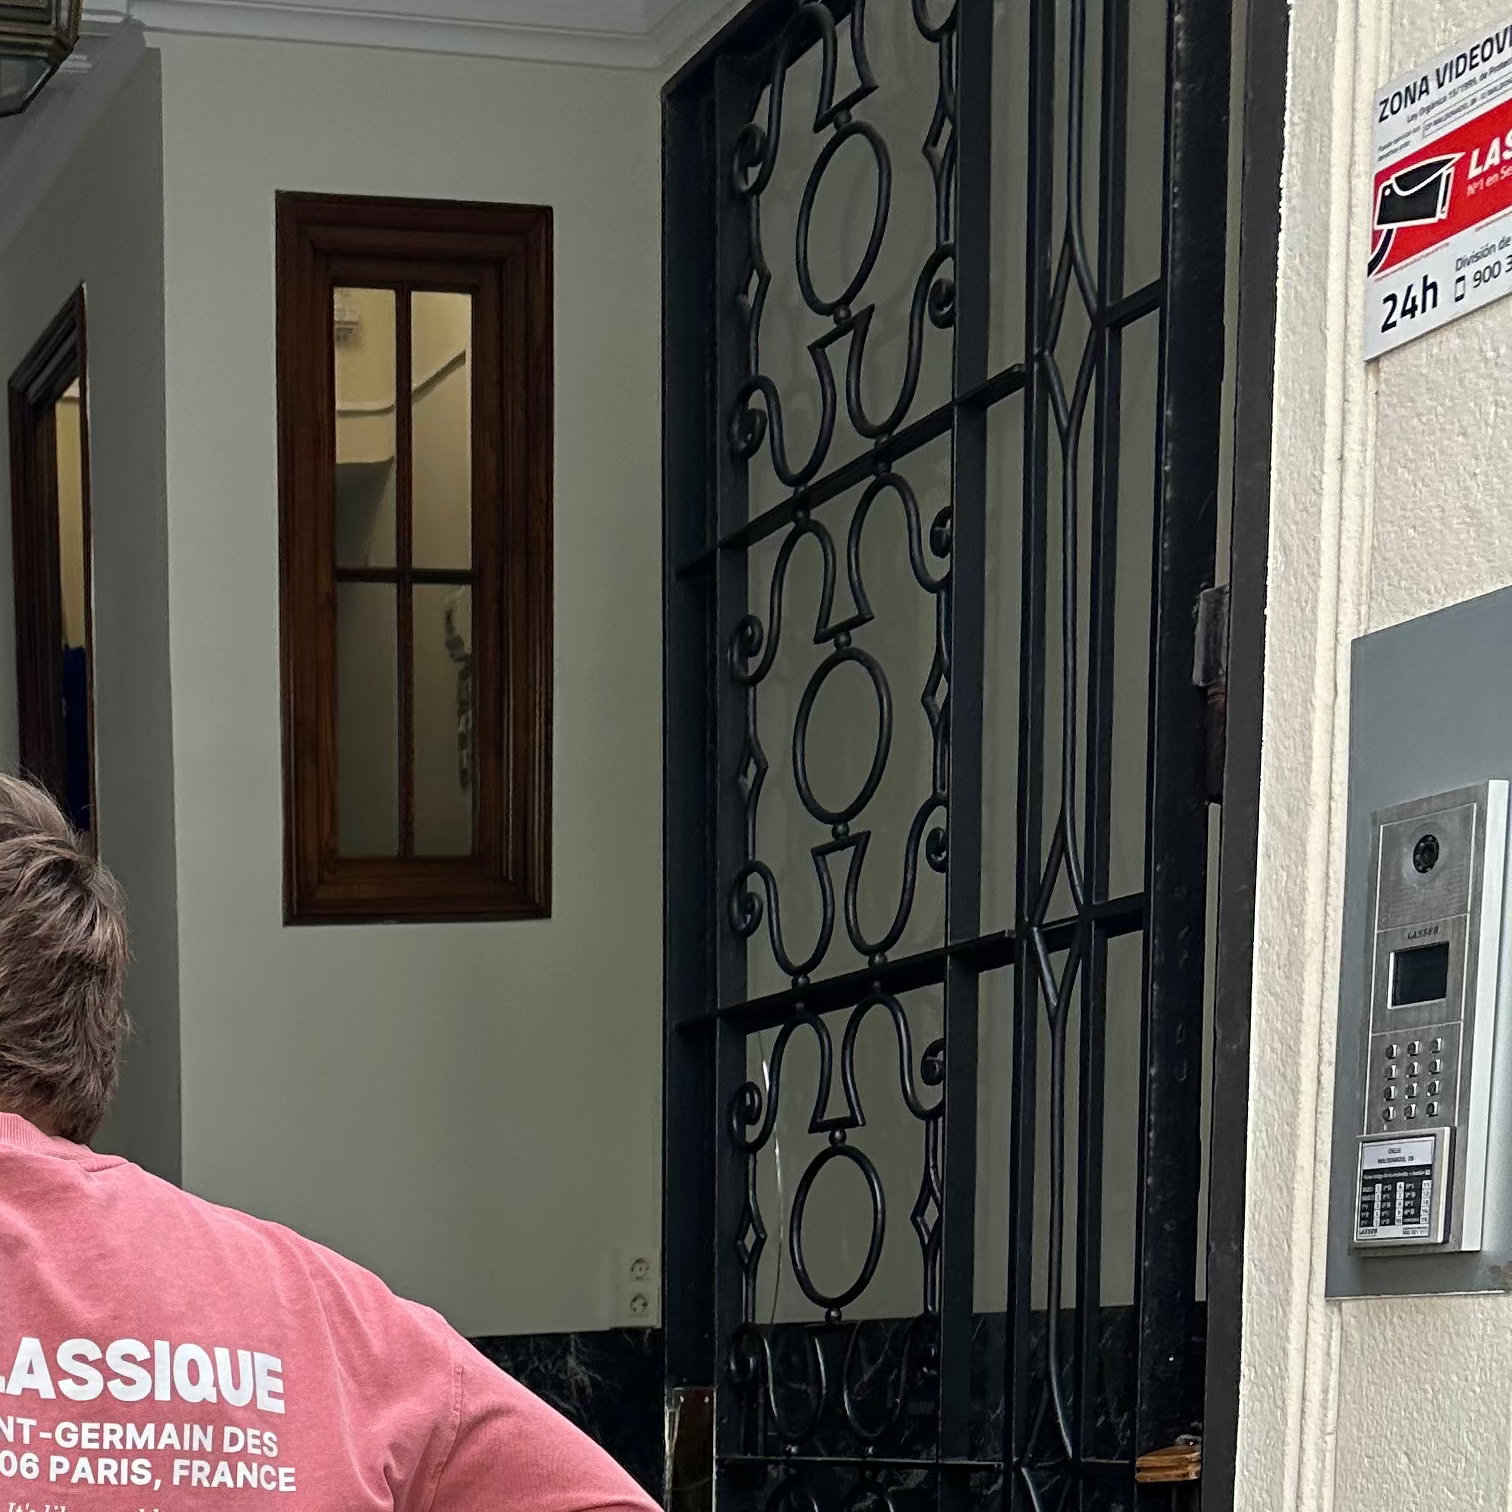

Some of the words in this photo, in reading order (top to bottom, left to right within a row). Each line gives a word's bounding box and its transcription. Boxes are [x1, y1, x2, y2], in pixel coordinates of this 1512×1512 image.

[1378, 75, 1429, 123] ZONA
[1455, 242, 1496, 272] División
[1498, 235, 1512, 251] de
[1473, 260, 1502, 289] 900
[1381, 274, 1438, 334] 24h
[223, 1426, 278, 1457] DES
[50, 1455, 162, 1490] PARIS,
[173, 1459, 296, 1491] FRANCE
